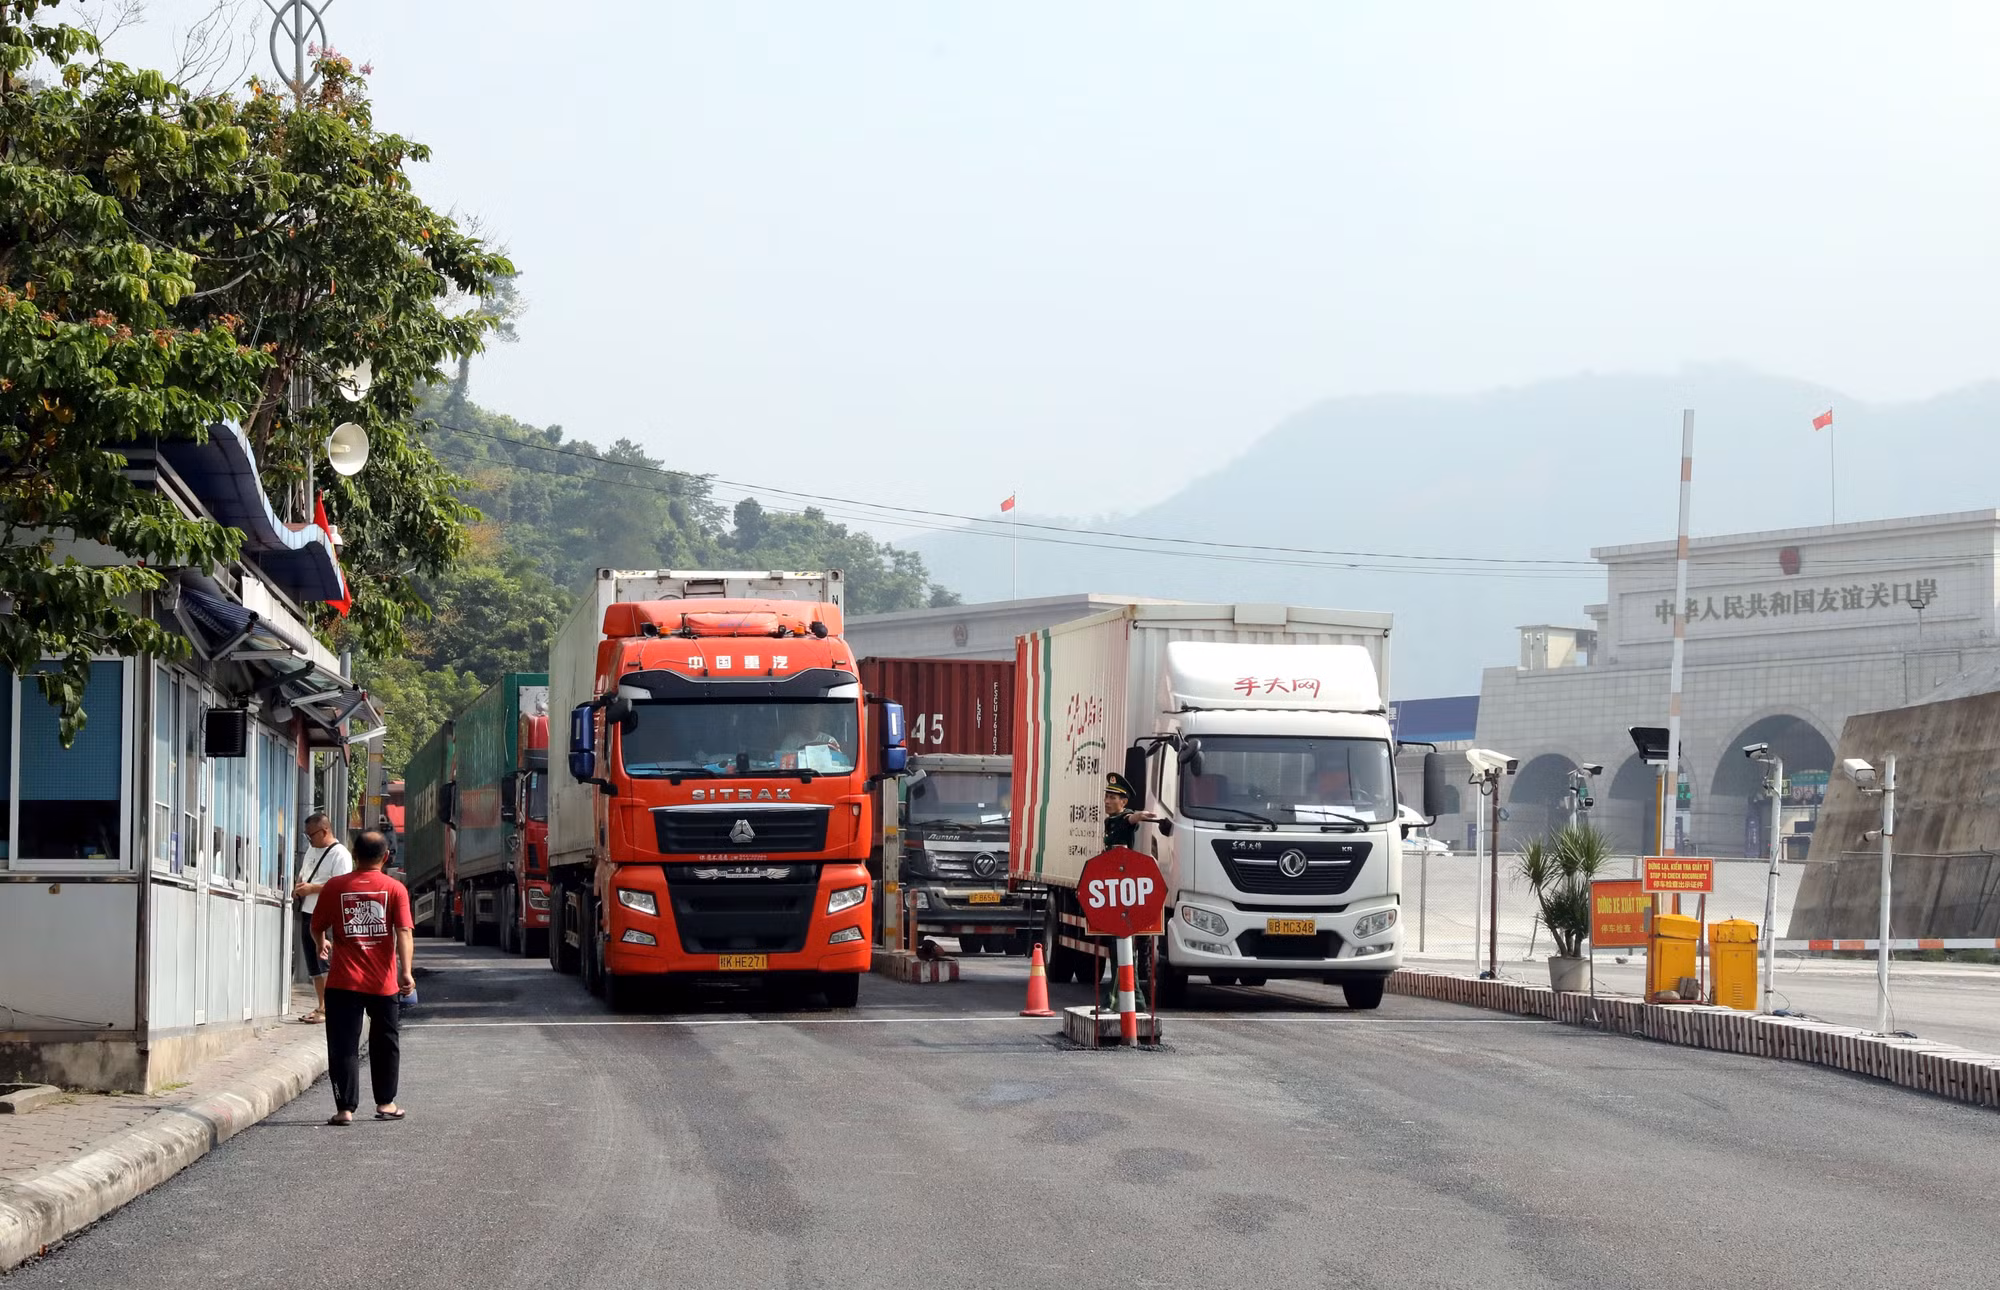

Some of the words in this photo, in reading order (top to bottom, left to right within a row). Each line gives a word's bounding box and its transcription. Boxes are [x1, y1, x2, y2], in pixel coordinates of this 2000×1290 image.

[1655, 578, 1938, 624] 中华人民共和国友谊关口岸
[688, 655, 789, 669] 中国重汽
[911, 713, 944, 745] 45
[692, 788, 792, 801] SITRAK
[1088, 877, 1154, 909] STOP
[1613, 897, 1621, 913] XE
